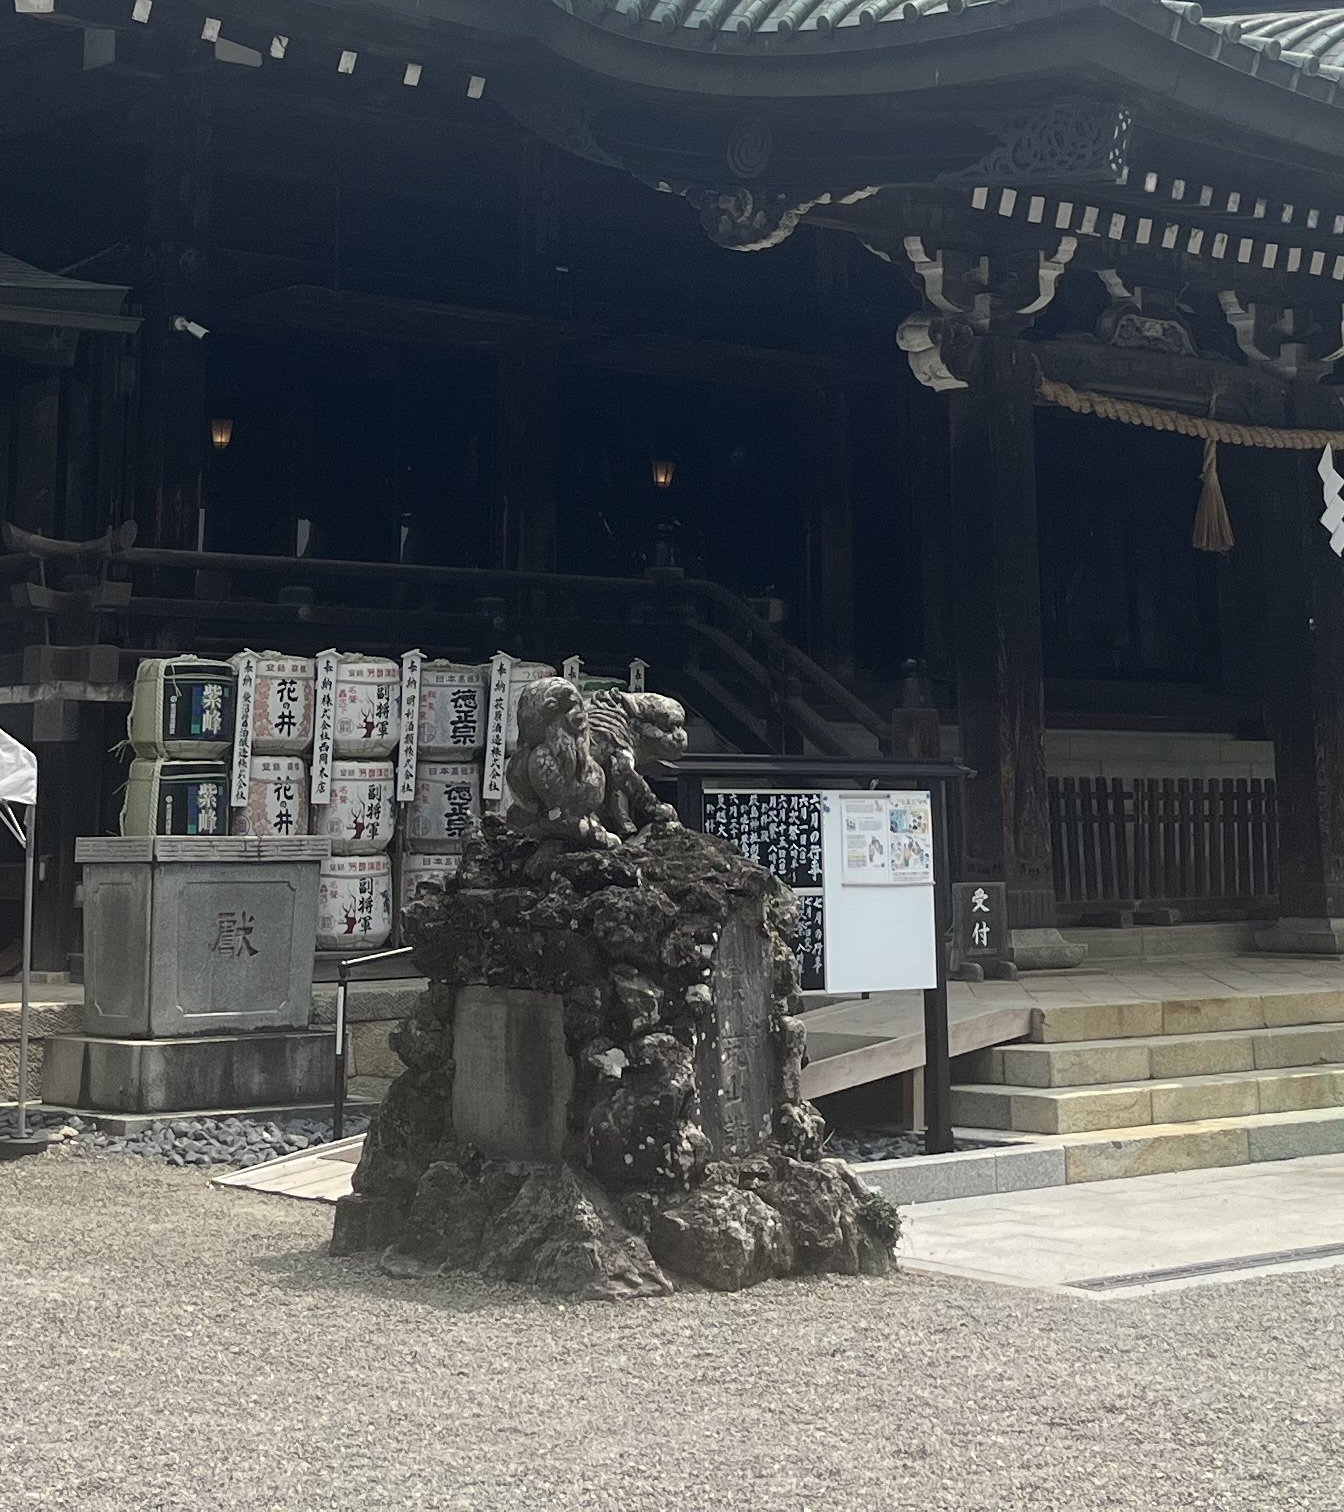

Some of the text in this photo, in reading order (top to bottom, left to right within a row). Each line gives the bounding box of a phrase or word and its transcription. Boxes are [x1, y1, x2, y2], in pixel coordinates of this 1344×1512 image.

[202, 683, 223, 735] 紫峰
[274, 679, 299, 738] 花の井
[375, 685, 391, 740] 副将軍
[197, 783, 218, 835] 紫峰
[273, 776, 297, 836] 花の井
[365, 784, 382, 840] 副将軍
[807, 793, 823, 882] 六月の行事
[357, 877, 374, 935] 副将軍
[971, 887, 991, 947] 受付
[812, 896, 823, 975] 七月の行事
